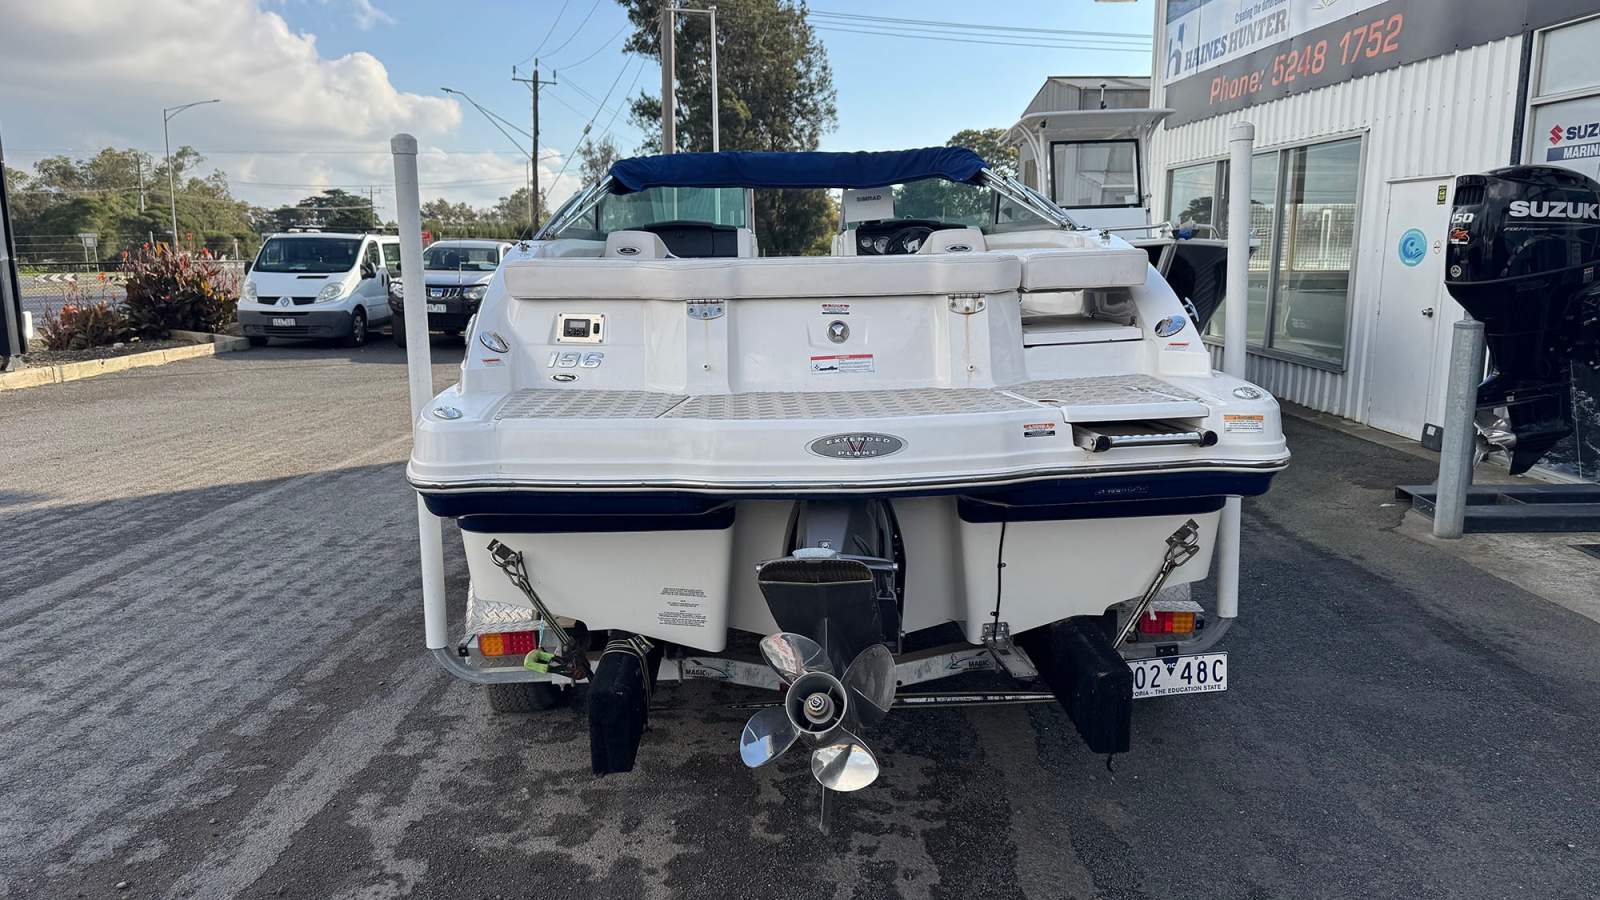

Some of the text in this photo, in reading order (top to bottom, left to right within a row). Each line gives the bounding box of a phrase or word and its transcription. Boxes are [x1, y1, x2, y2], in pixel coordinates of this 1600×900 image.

[1235, 7, 1253, 24] Creating
[1253, 3, 1261, 15] the
[1184, 8, 1287, 71] HAINES HUNTER
[1209, 13, 1404, 105] Phone: 5248 1752
[1566, 123, 1600, 141] SUZ
[1563, 143, 1600, 159] MARIN
[1509, 201, 1600, 219] SUZUK
[547, 352, 605, 368] 196
[826, 435, 890, 445] EXTENDED
[1180, 659, 1224, 685] 48C
[1155, 687, 1166, 695] THE
[1168, 684, 1201, 693] EDUCATION
[1203, 683, 1221, 691] STATE
